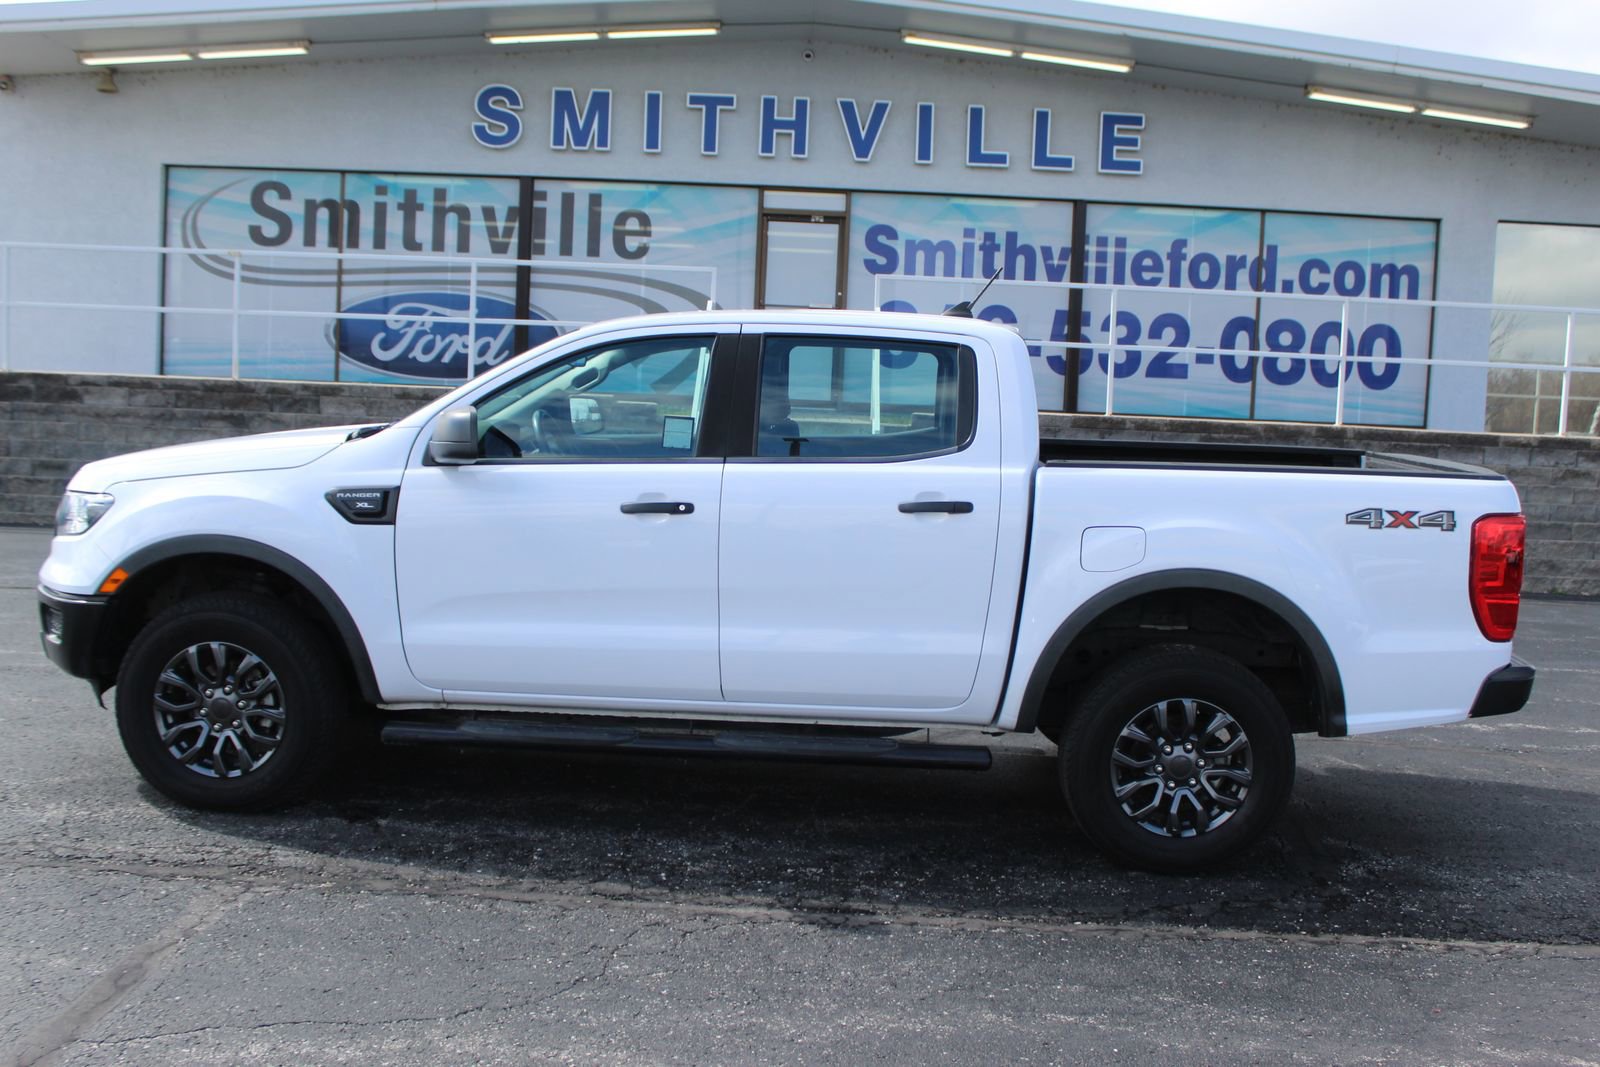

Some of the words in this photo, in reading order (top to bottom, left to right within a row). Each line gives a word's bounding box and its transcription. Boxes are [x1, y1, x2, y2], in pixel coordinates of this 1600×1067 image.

[470, 82, 1147, 176] SMITHVILLE
[248, 180, 653, 260] Smithville
[370, 302, 514, 366] Ford
